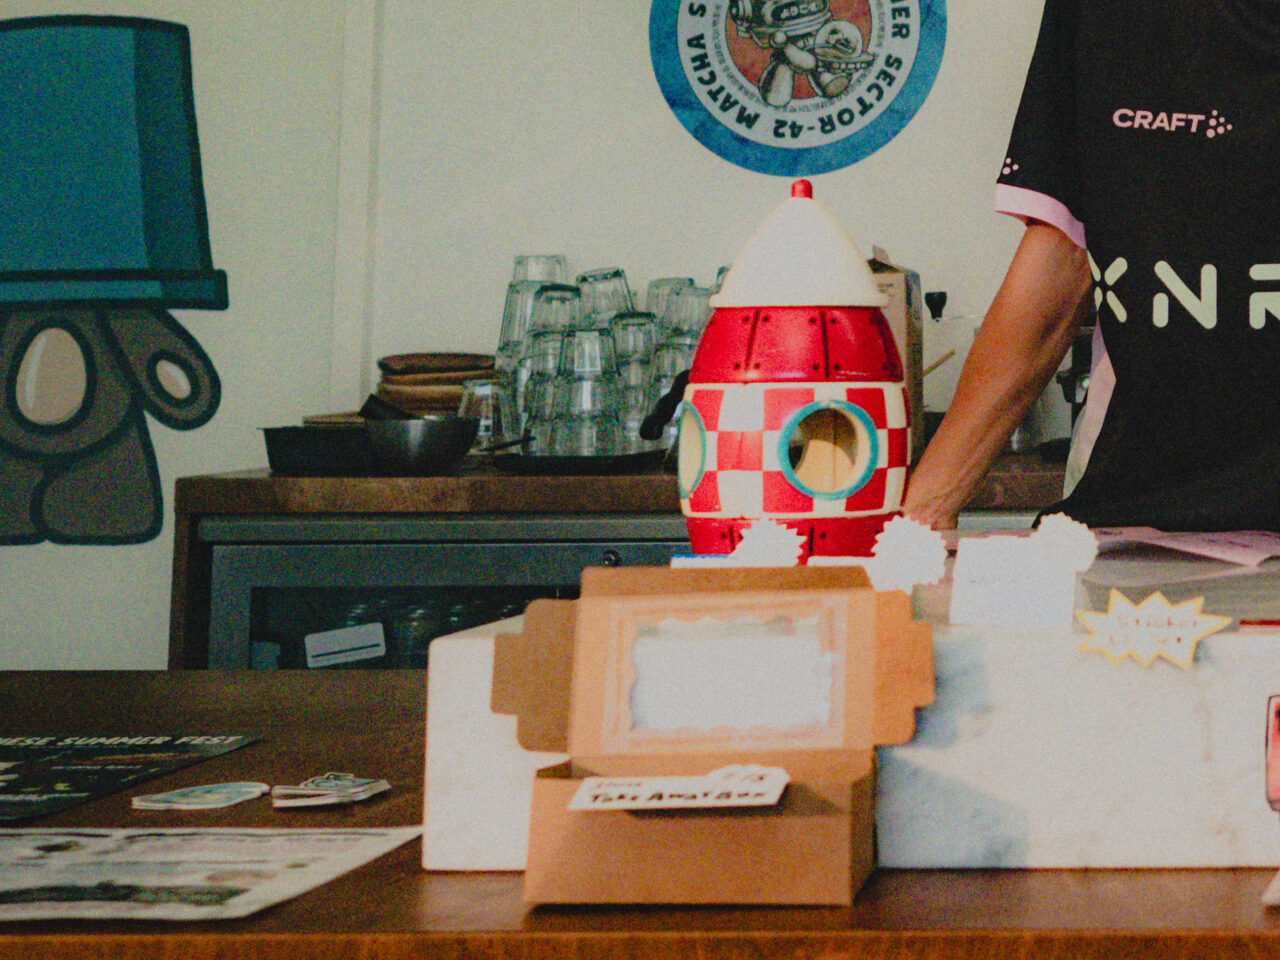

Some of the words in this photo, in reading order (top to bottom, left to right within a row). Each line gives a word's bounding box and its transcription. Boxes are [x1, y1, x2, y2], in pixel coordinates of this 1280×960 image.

[686, 33, 761, 130] MATCHA
[772, 53, 904, 139] SECTOR-42
[1112, 108, 1206, 133] CRAFT
